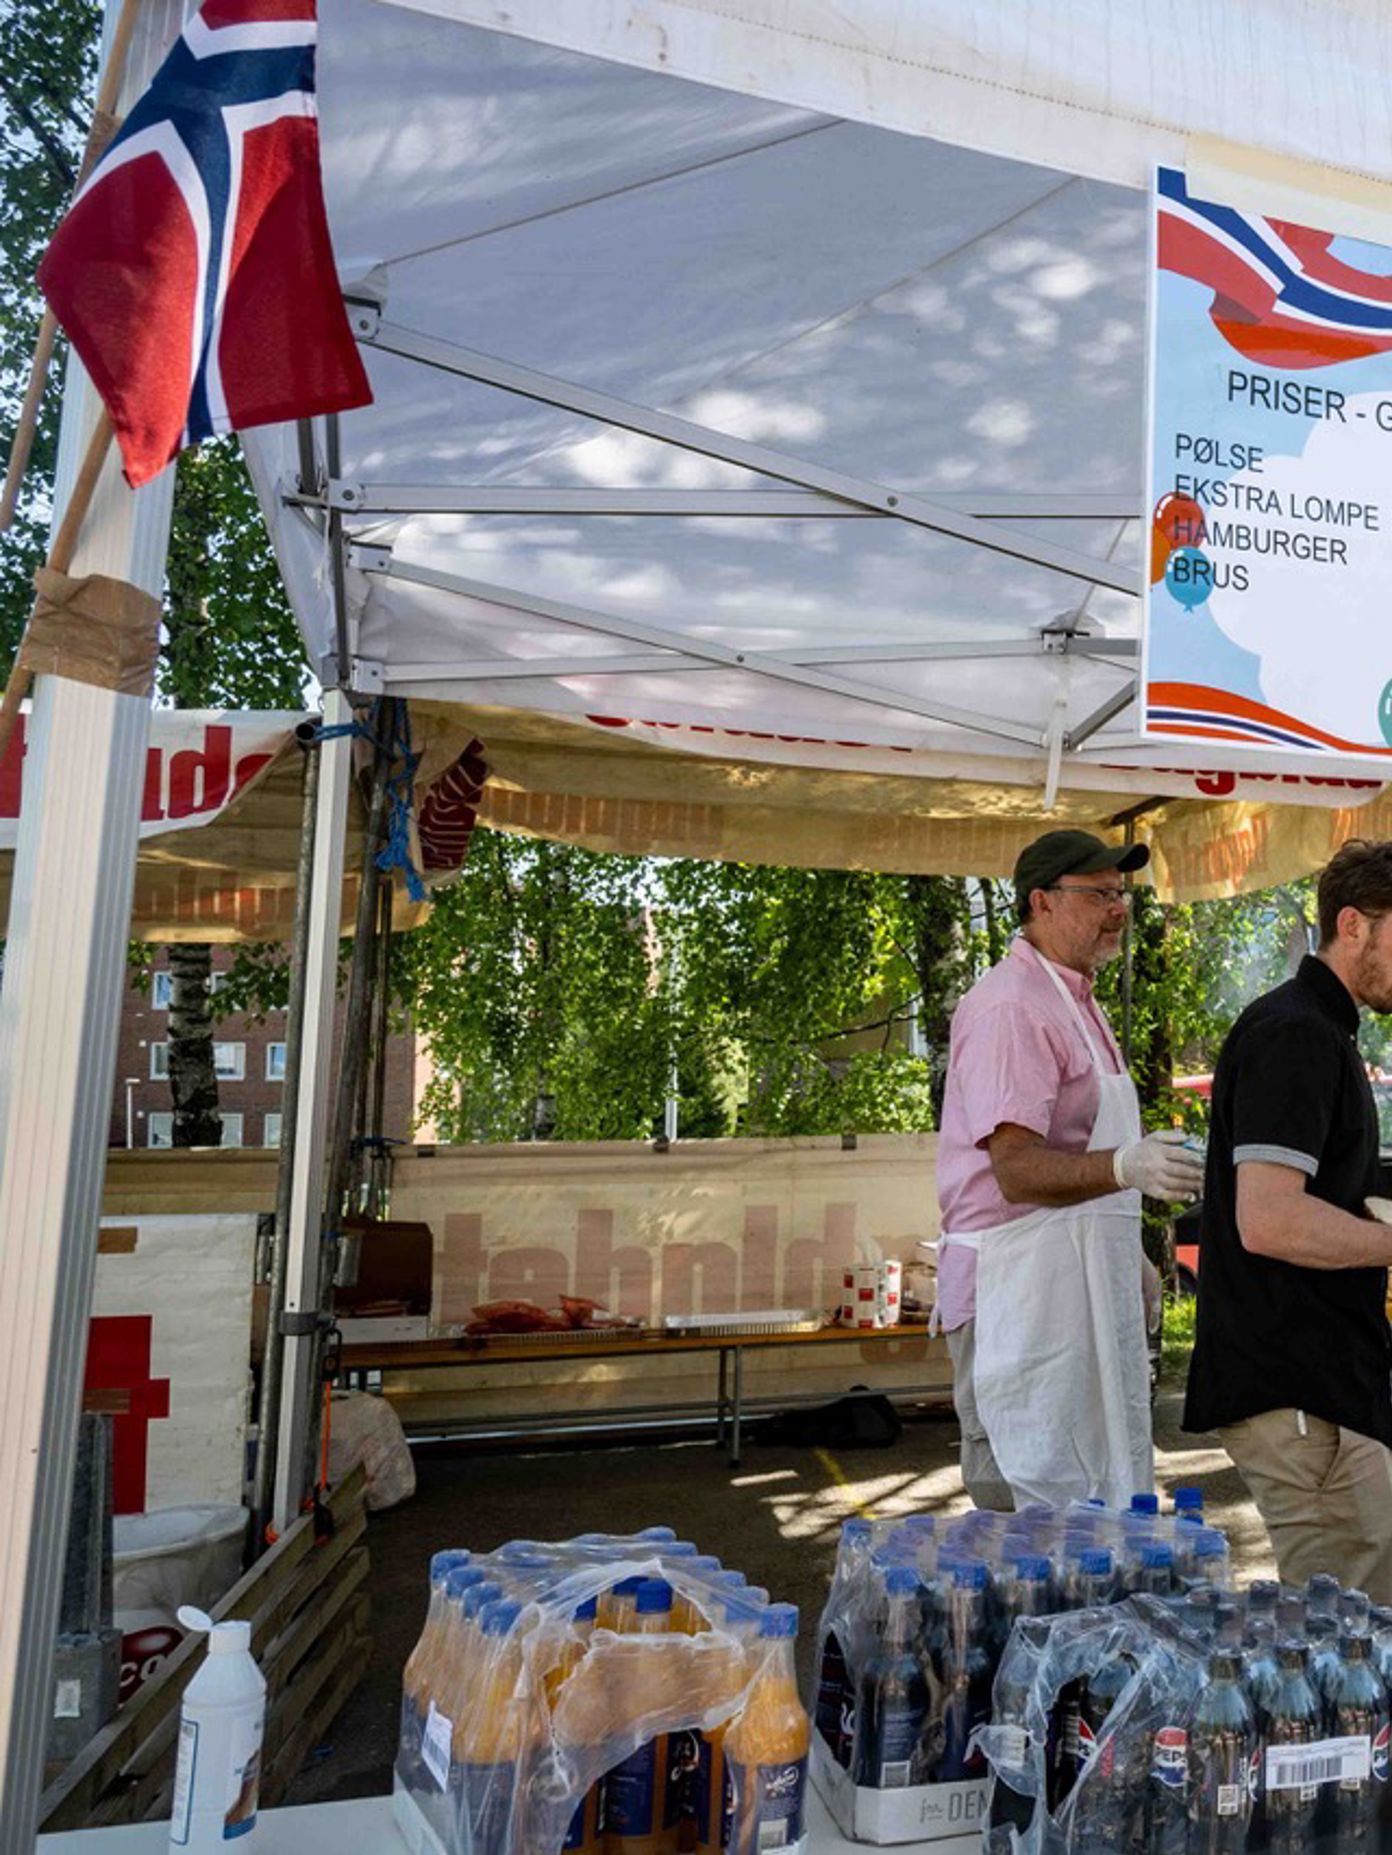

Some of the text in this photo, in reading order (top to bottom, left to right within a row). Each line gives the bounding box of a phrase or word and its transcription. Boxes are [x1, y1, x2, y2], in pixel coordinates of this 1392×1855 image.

[1227, 370, 1347, 423] PRISER
[1175, 433, 1264, 473] PØLSE
[1175, 474, 1283, 516] EKSTRA
[1290, 493, 1380, 531] LOMPE
[1173, 515, 1348, 565] HAMBURGER
[1173, 556, 1250, 591] BRUS
